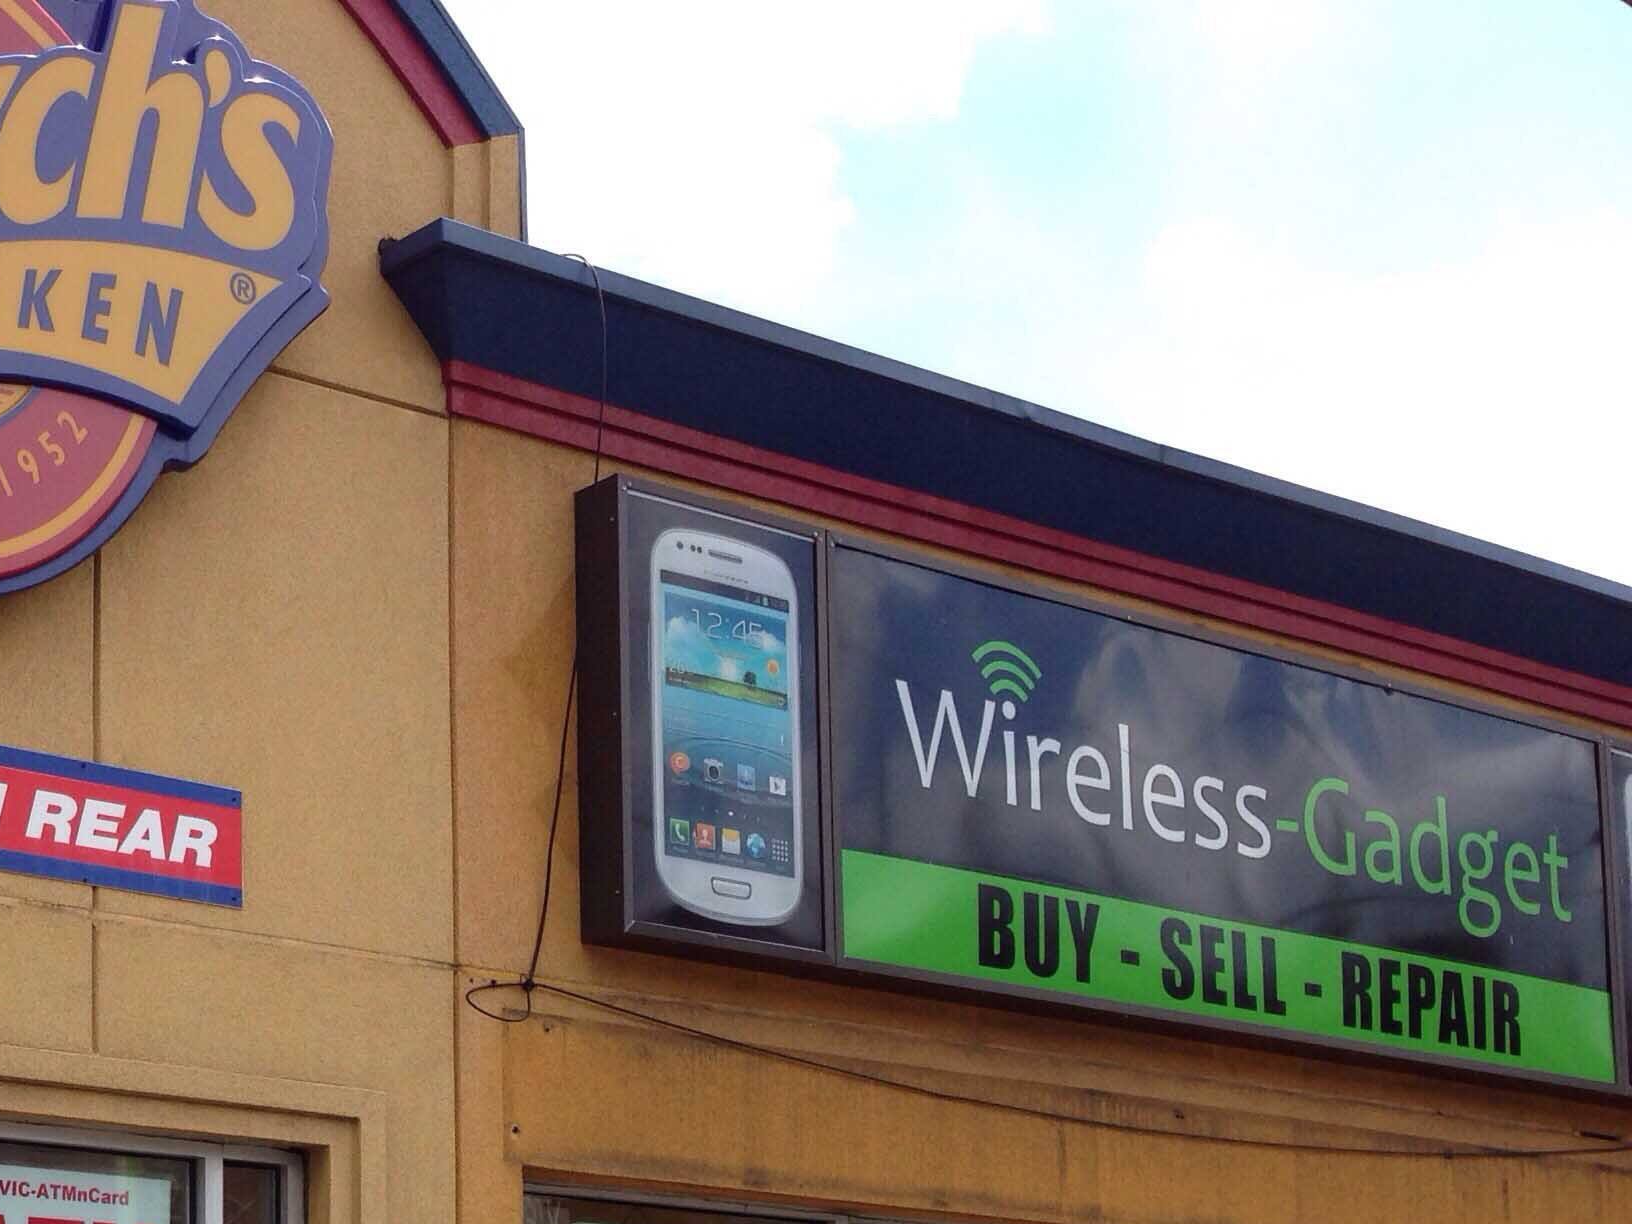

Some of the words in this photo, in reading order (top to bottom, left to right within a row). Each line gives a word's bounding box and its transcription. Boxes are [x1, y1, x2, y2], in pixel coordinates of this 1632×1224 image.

[691, 608, 762, 648] 12:45
[24, 790, 219, 869] REAR
[895, 678, 1572, 938] Wireless-Gadget
[977, 885, 1101, 986] BUY
[1161, 916, 1287, 1018] SELL
[1342, 975, 1524, 1058] REPAIR
